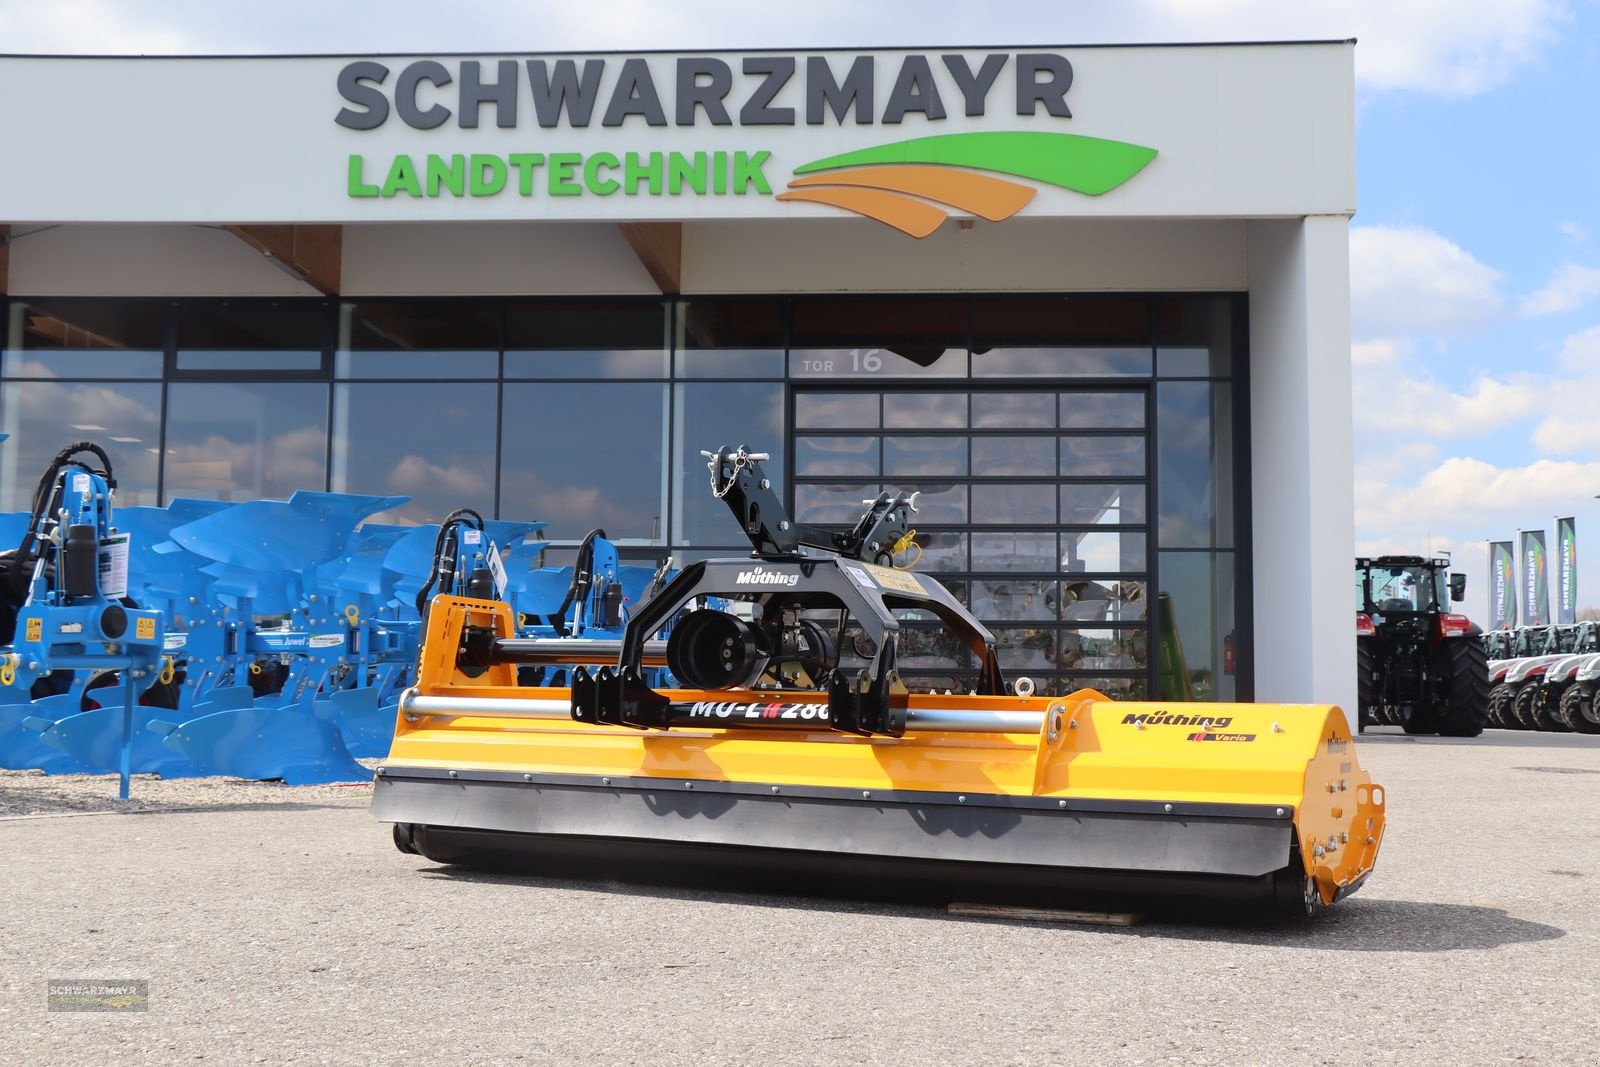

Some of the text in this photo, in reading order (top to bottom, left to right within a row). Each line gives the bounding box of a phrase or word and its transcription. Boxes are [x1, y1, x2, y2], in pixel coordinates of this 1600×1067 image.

[334, 53, 1074, 131] SCHWARZMAYR
[347, 150, 773, 198] LANDTECHNIK
[803, 348, 882, 372] TOR 16
[1528, 550, 1536, 617] SCHWARZMAYR
